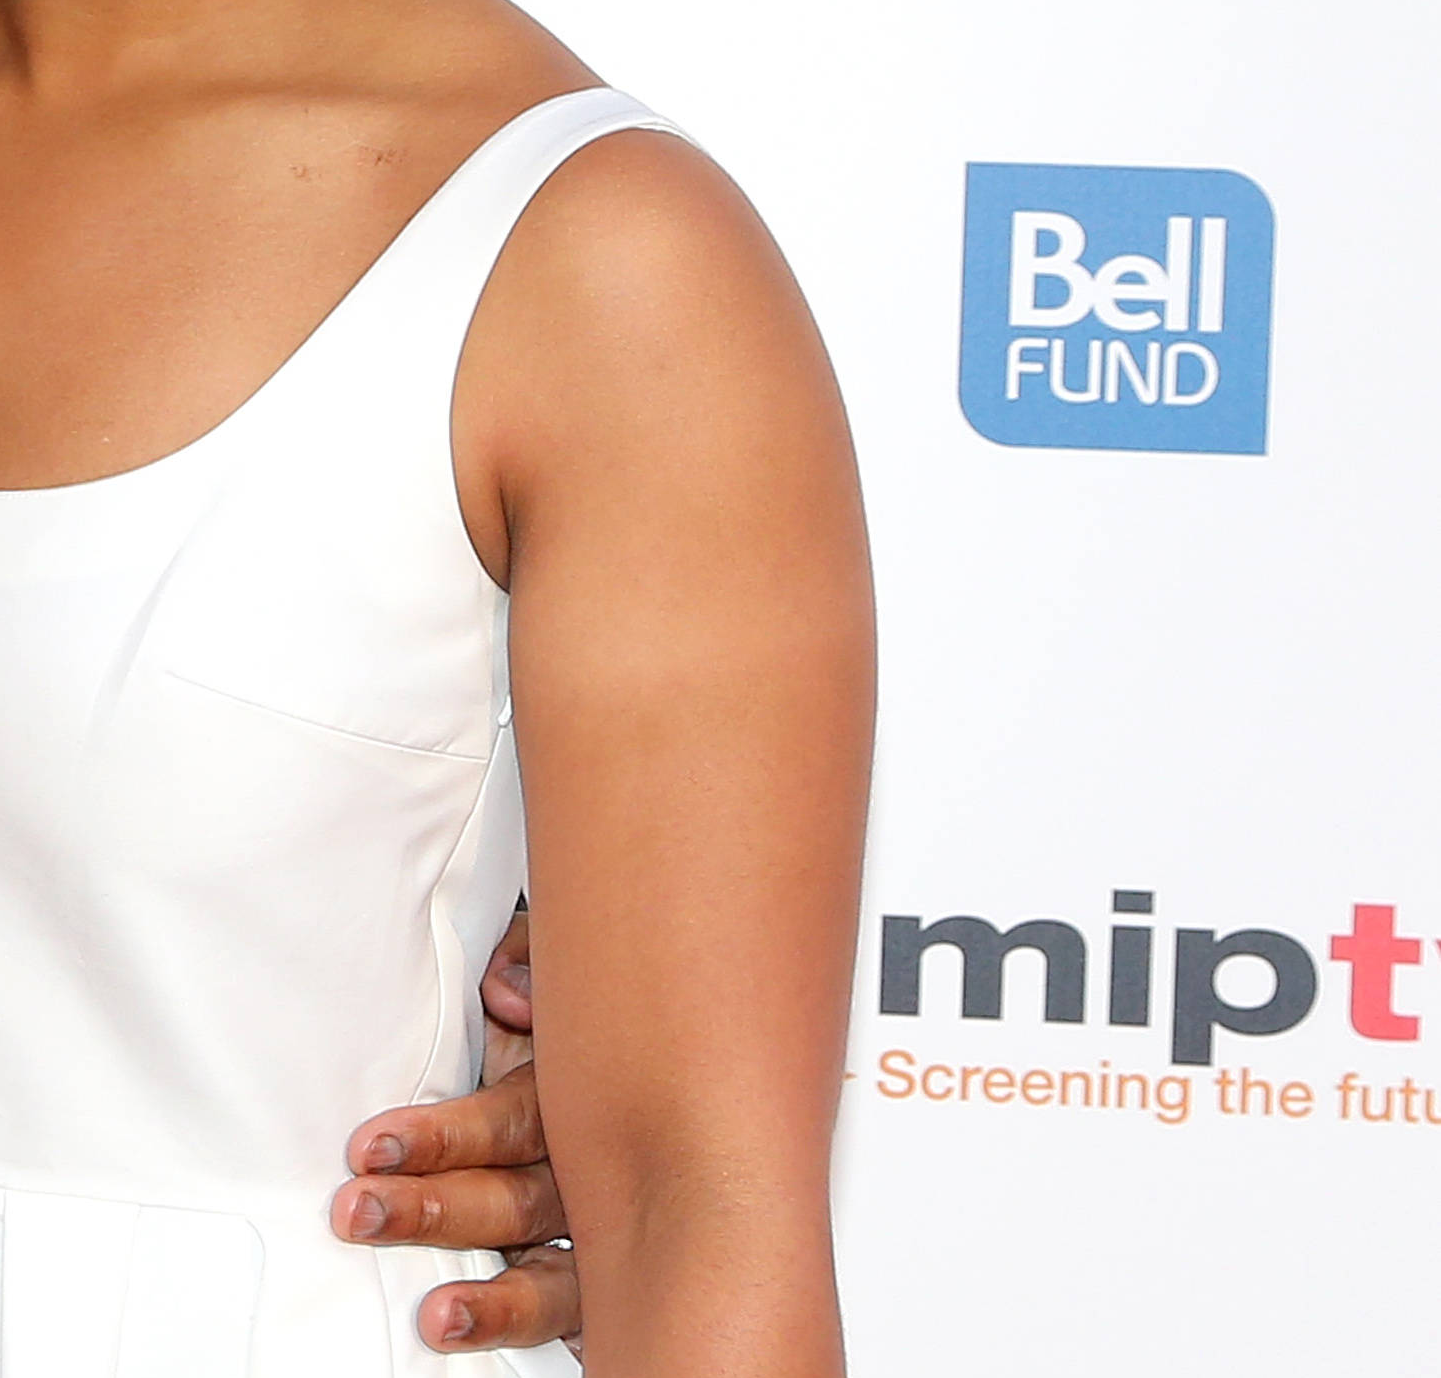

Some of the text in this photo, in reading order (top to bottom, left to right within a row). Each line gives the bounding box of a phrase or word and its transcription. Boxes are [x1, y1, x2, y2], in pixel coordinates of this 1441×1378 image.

[1008, 211, 1227, 333] Bell
[1006, 337, 1219, 406] FUND
[878, 889, 1441, 1066] mipt
[877, 1050, 1441, 1125] Screening the fut
